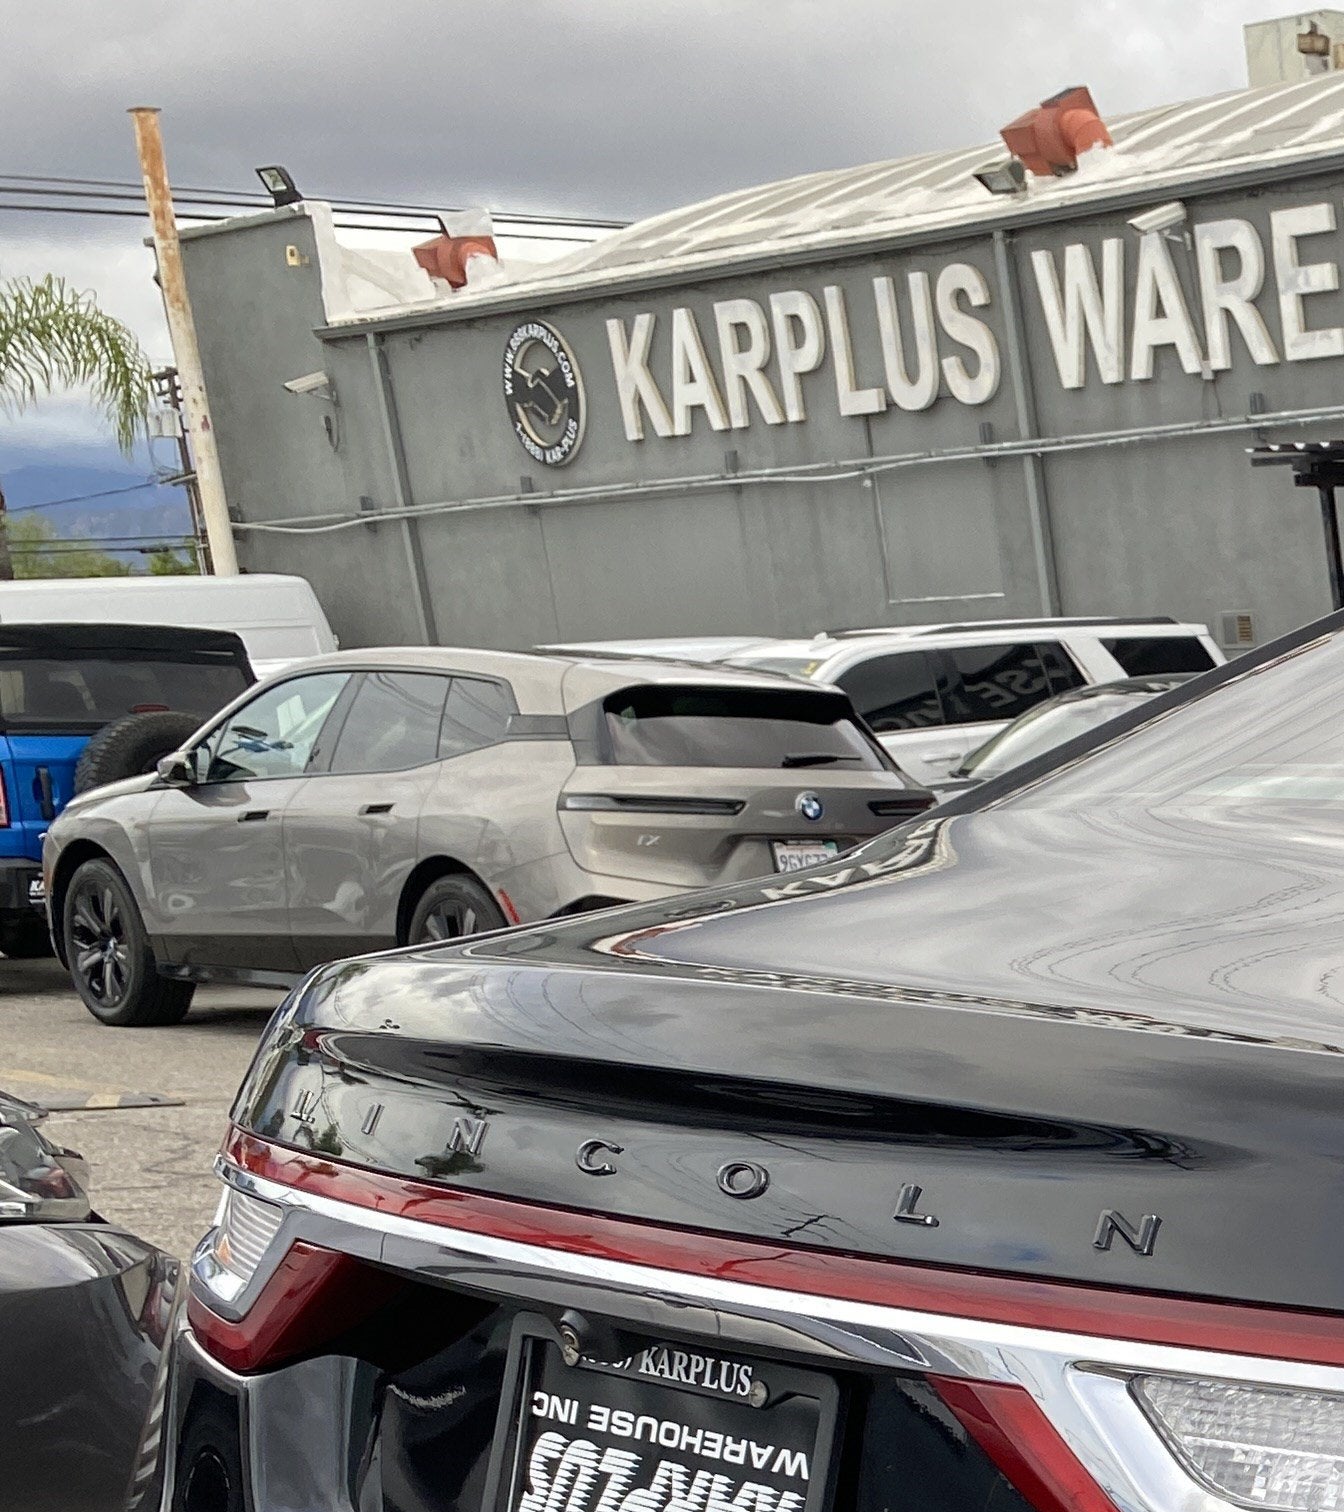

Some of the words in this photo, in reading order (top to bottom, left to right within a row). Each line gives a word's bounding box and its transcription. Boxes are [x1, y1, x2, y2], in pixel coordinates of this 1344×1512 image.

[605, 261, 1002, 442] KARPLUS
[290, 1087, 1162, 1257] LINCOLN
[531, 1390, 579, 1425] INC
[638, 1345, 753, 1397] KARPLUS
[587, 1404, 811, 1480] WAREHOUSE
